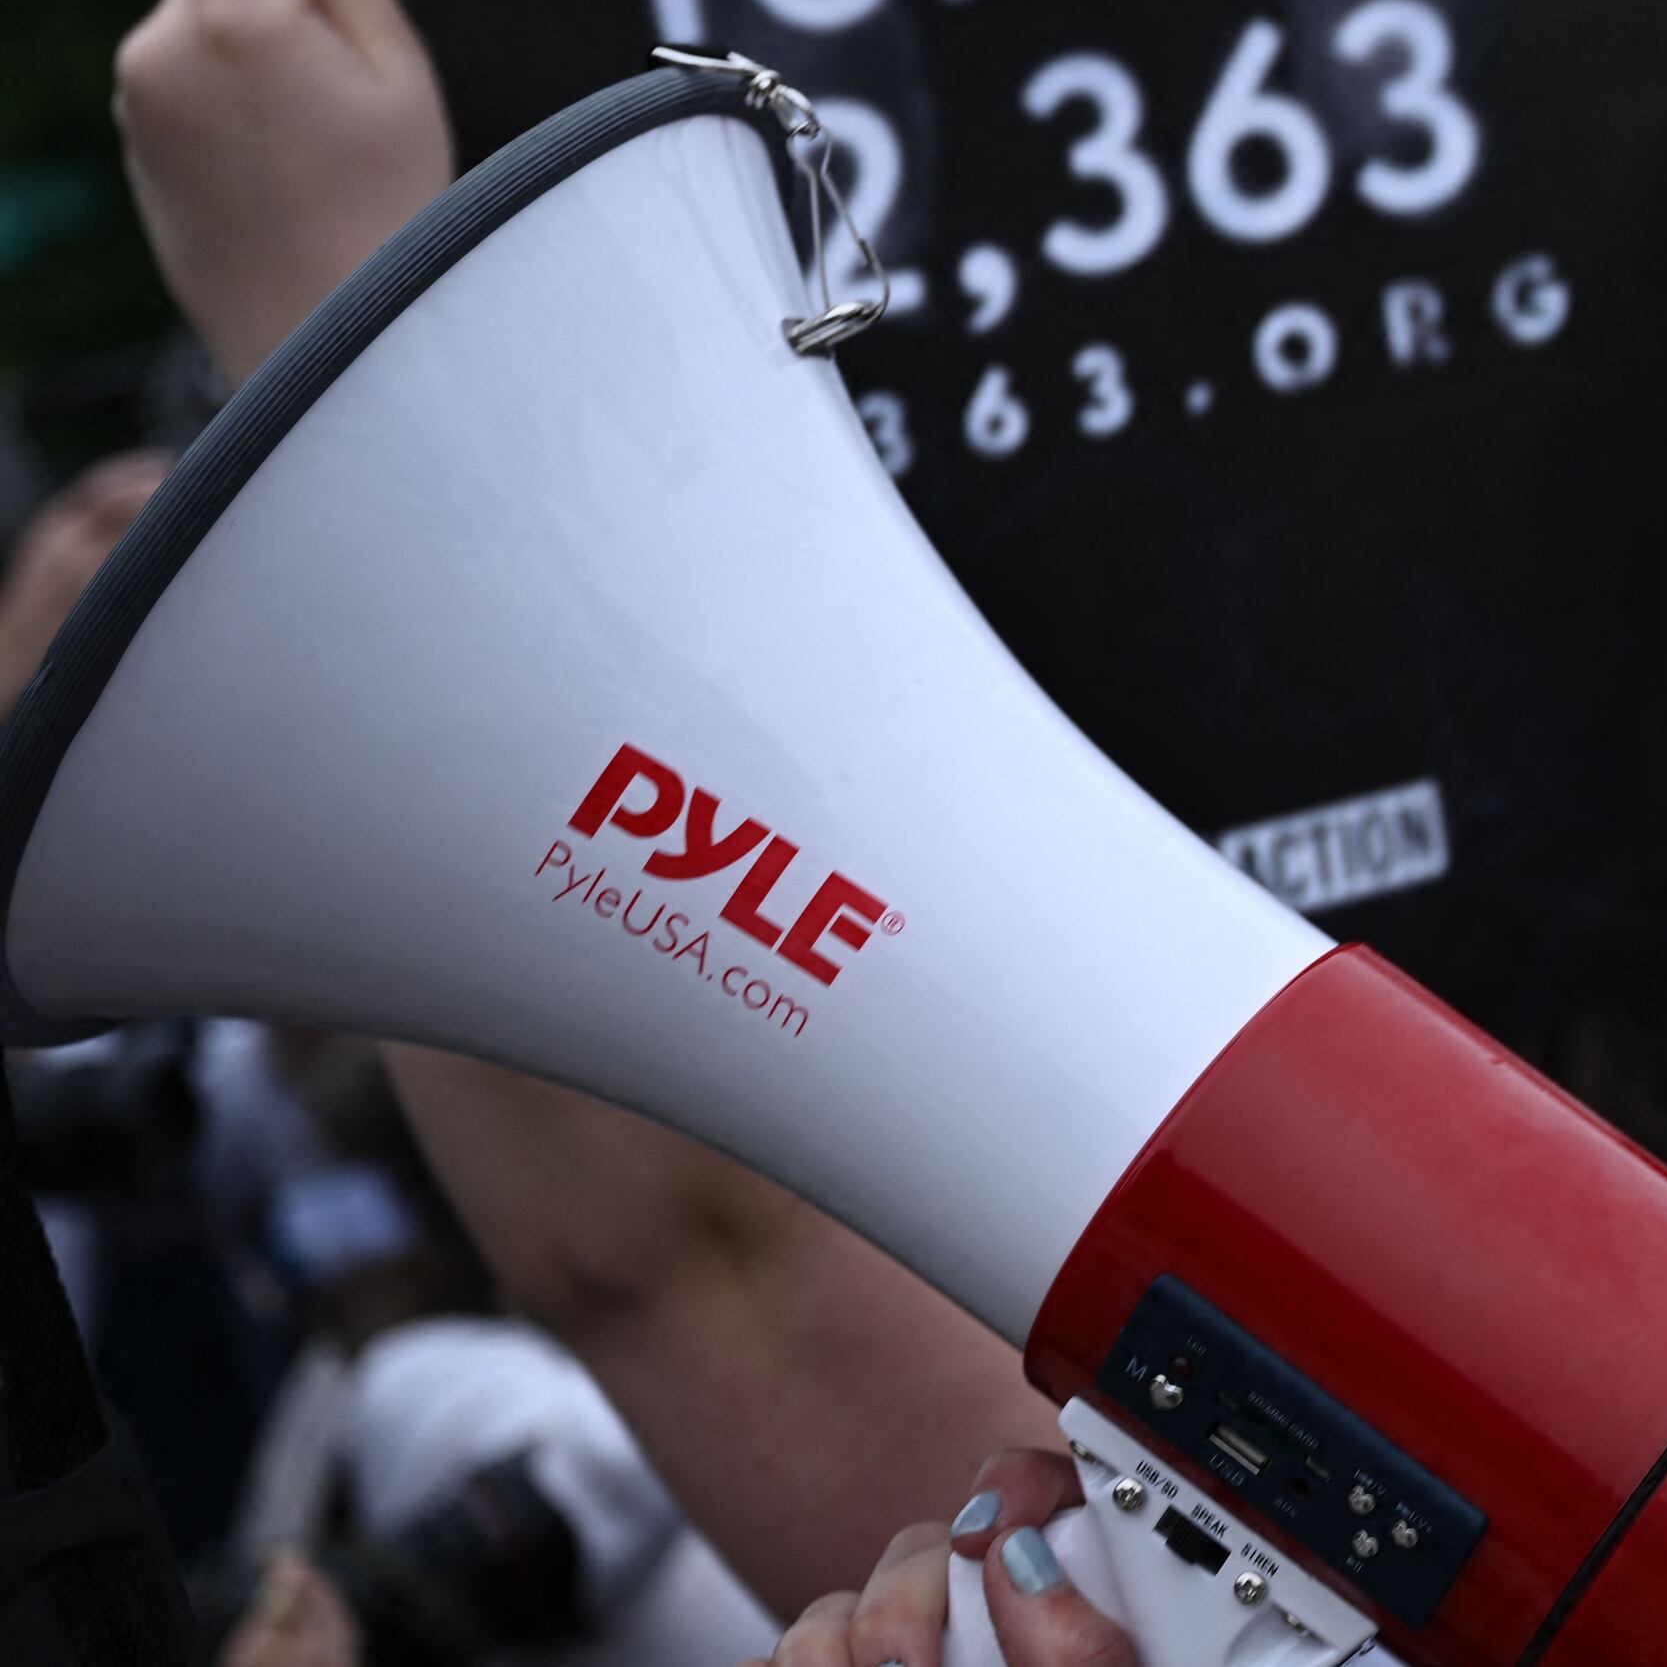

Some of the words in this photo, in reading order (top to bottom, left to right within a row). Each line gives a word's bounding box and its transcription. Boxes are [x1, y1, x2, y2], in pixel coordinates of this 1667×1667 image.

[856, 250, 1572, 480] 363.ORG
[535, 839, 810, 1037] PyleUSA.com
[1125, 1355, 1149, 1382] M
[1135, 1459, 1179, 1499] USB/SD
[1190, 1503, 1228, 1539] SPEAK
[1240, 1541, 1280, 1577] SIREN
